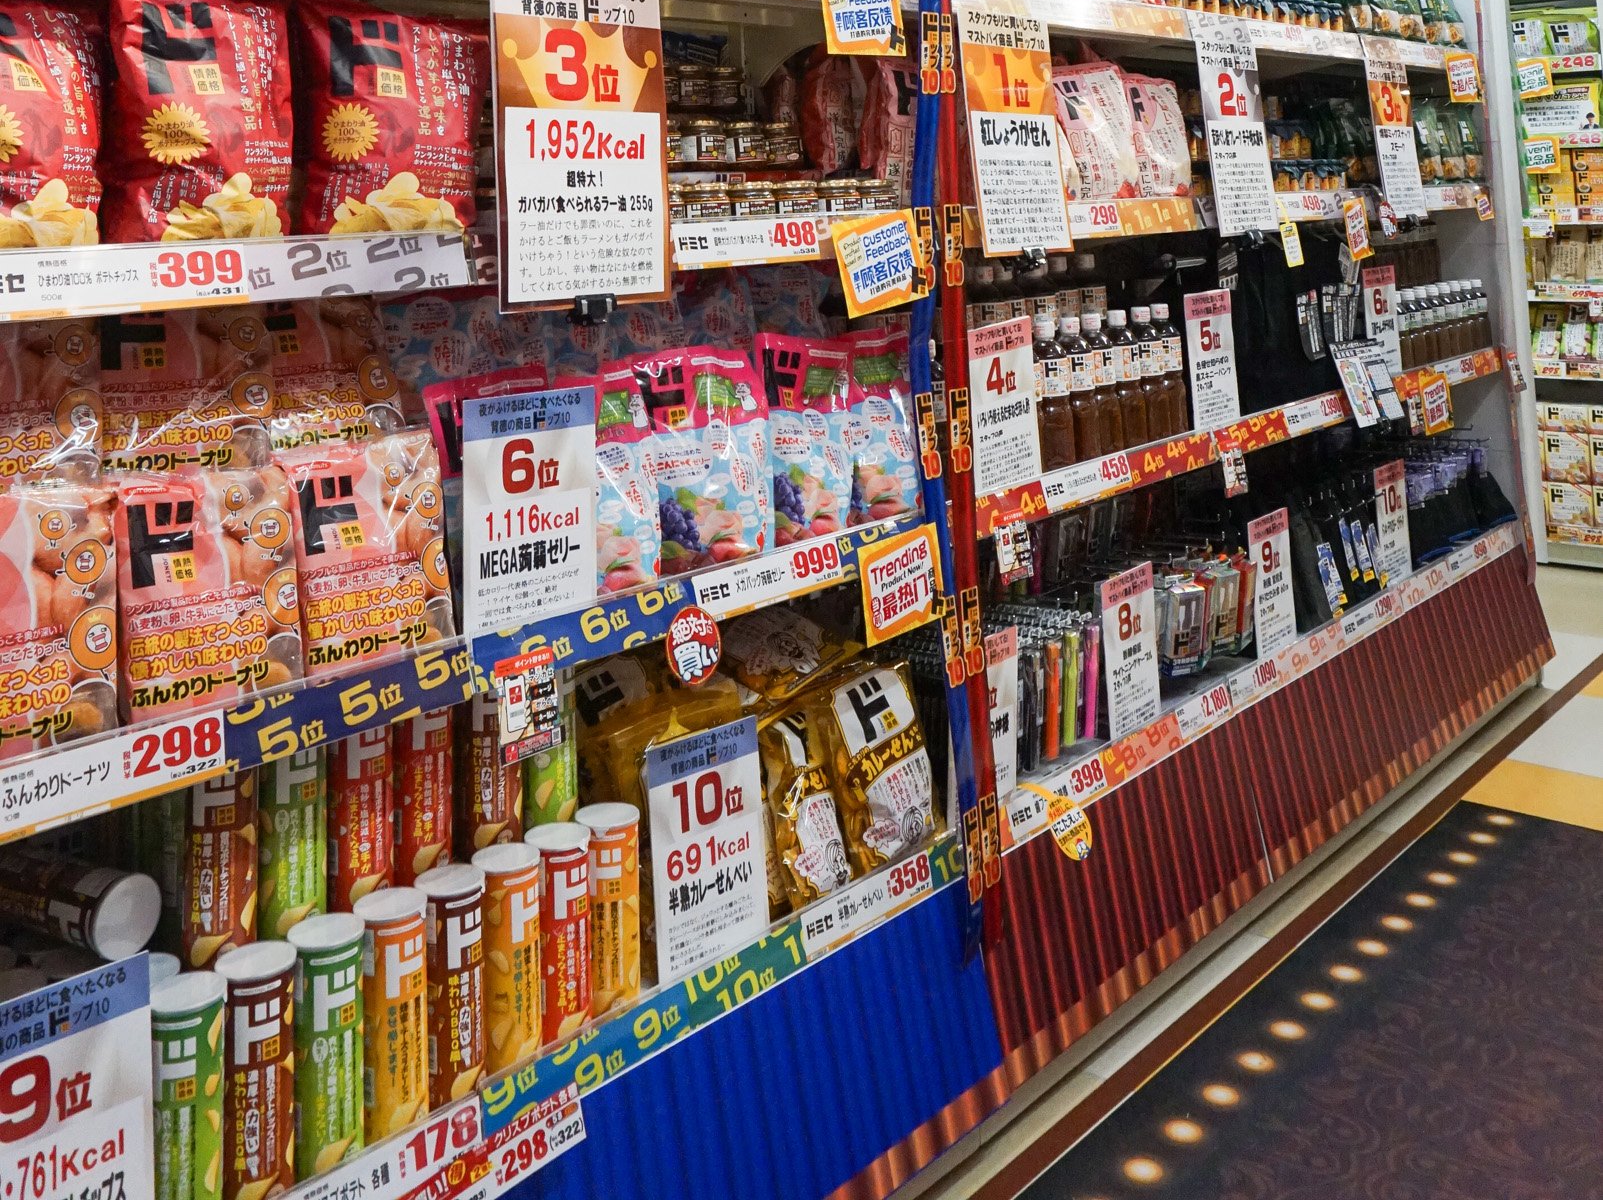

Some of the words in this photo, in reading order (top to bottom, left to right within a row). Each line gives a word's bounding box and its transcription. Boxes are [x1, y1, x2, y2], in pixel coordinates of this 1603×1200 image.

[545, 27, 621, 103] 3位
[993, 52, 1030, 108] 1位
[1217, 71, 1248, 117] 2位
[526, 118, 646, 162] 1,952Kcal
[980, 116, 1051, 148] 紅しょうがせん
[518, 194, 627, 214] ガバガバ食べられるラー油
[630, 194, 653, 213] 255g
[1090, 204, 1118, 226] 298
[773, 220, 816, 249] 498
[862, 220, 908, 247] Customer
[865, 234, 912, 262] Feedback
[38, 272, 93, 288] ひまわり油100%
[96, 268, 139, 283] ポテトチップス
[158, 249, 244, 288] 399
[287, 242, 352, 281] 2位
[1200, 319, 1222, 352] 5位
[986, 356, 1017, 396] 4位
[502, 437, 560, 495] 6位
[1101, 454, 1129, 482] 458
[340, 524, 361, 536] 情熱
[343, 534, 364, 546] 価格
[485, 503, 580, 543] 1,116Kcal
[172, 557, 192, 569] 情熱
[175, 568, 195, 580] 価格
[699, 583, 731, 606] ドミセ
[793, 542, 840, 579] 999
[870, 540, 928, 586] Trending
[305, 578, 425, 620] 伝統の製法でつくった
[307, 597, 426, 642] 懐かしい味わいの
[129, 613, 267, 659] 伝統の製法でつくった
[308, 619, 429, 666] ふんわりドーナツ
[580, 606, 630, 644] 6位
[1117, 602, 1142, 642] 8位
[129, 634, 269, 682] 懐かしい味わいの
[417, 649, 472, 690] 5位
[673, 640, 719, 682] 買い
[132, 660, 270, 709] ふんわりドーナツ
[342, 679, 404, 724] 5位
[131, 716, 222, 779] 298
[260, 718, 328, 763] 5位
[2, 760, 111, 810] ふんわりドーナツ
[1071, 758, 1104, 794] 398
[672, 770, 745, 834] 10位
[666, 831, 751, 883] 691Kcal
[889, 853, 931, 898] 358
[668, 860, 753, 917] 半熟カレーせんべい
[633, 1004, 681, 1049] 9位
[405, 1104, 479, 1173] 178
[500, 1128, 549, 1186] 298
